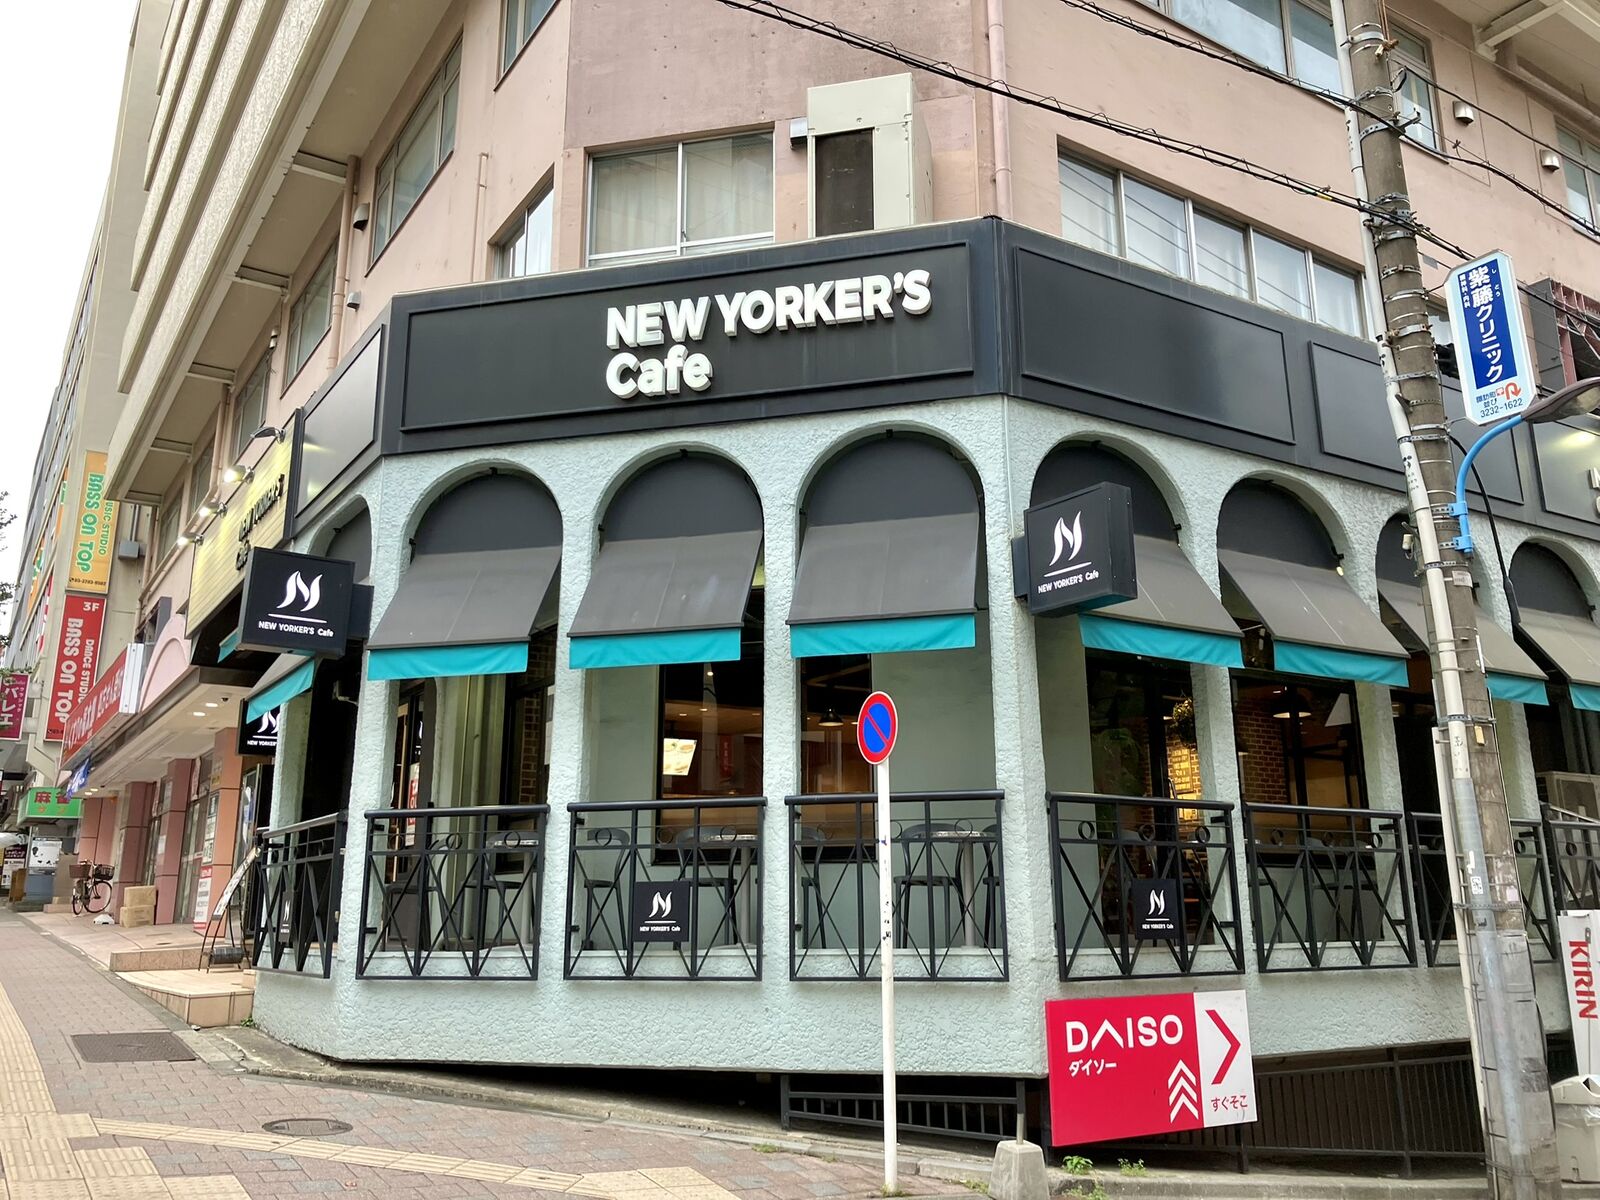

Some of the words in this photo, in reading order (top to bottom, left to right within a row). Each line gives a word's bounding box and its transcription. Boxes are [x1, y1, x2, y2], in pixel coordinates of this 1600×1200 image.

[606, 296, 712, 350] NEW
[714, 269, 933, 337] YORKER'S
[1468, 265, 1504, 383] 紫藤クリニック
[605, 344, 714, 399] Cafe
[1480, 397, 1524, 418] 3232-1622
[84, 472, 104, 510] BASS
[103, 500, 113, 521] USIC
[98, 524, 110, 556] STUDIO
[1038, 581, 1052, 594] NEW
[1053, 574, 1084, 590] YORKER'S
[1085, 569, 1099, 581] Cafe
[82, 601, 100, 612] 3F
[63, 617, 84, 657] BASS
[258, 620, 277, 631] NEW
[279, 622, 315, 636] YORKER'S
[317, 627, 334, 638] Cafe
[83, 638, 95, 670] DANCE
[55, 689, 74, 724] TOP
[1568, 940, 1599, 1019] KIRIN
[1065, 1014, 1184, 1054] DAISO
[1068, 1059, 1117, 1078] ダイソー
[1210, 1094, 1248, 1112] すぐそこ
